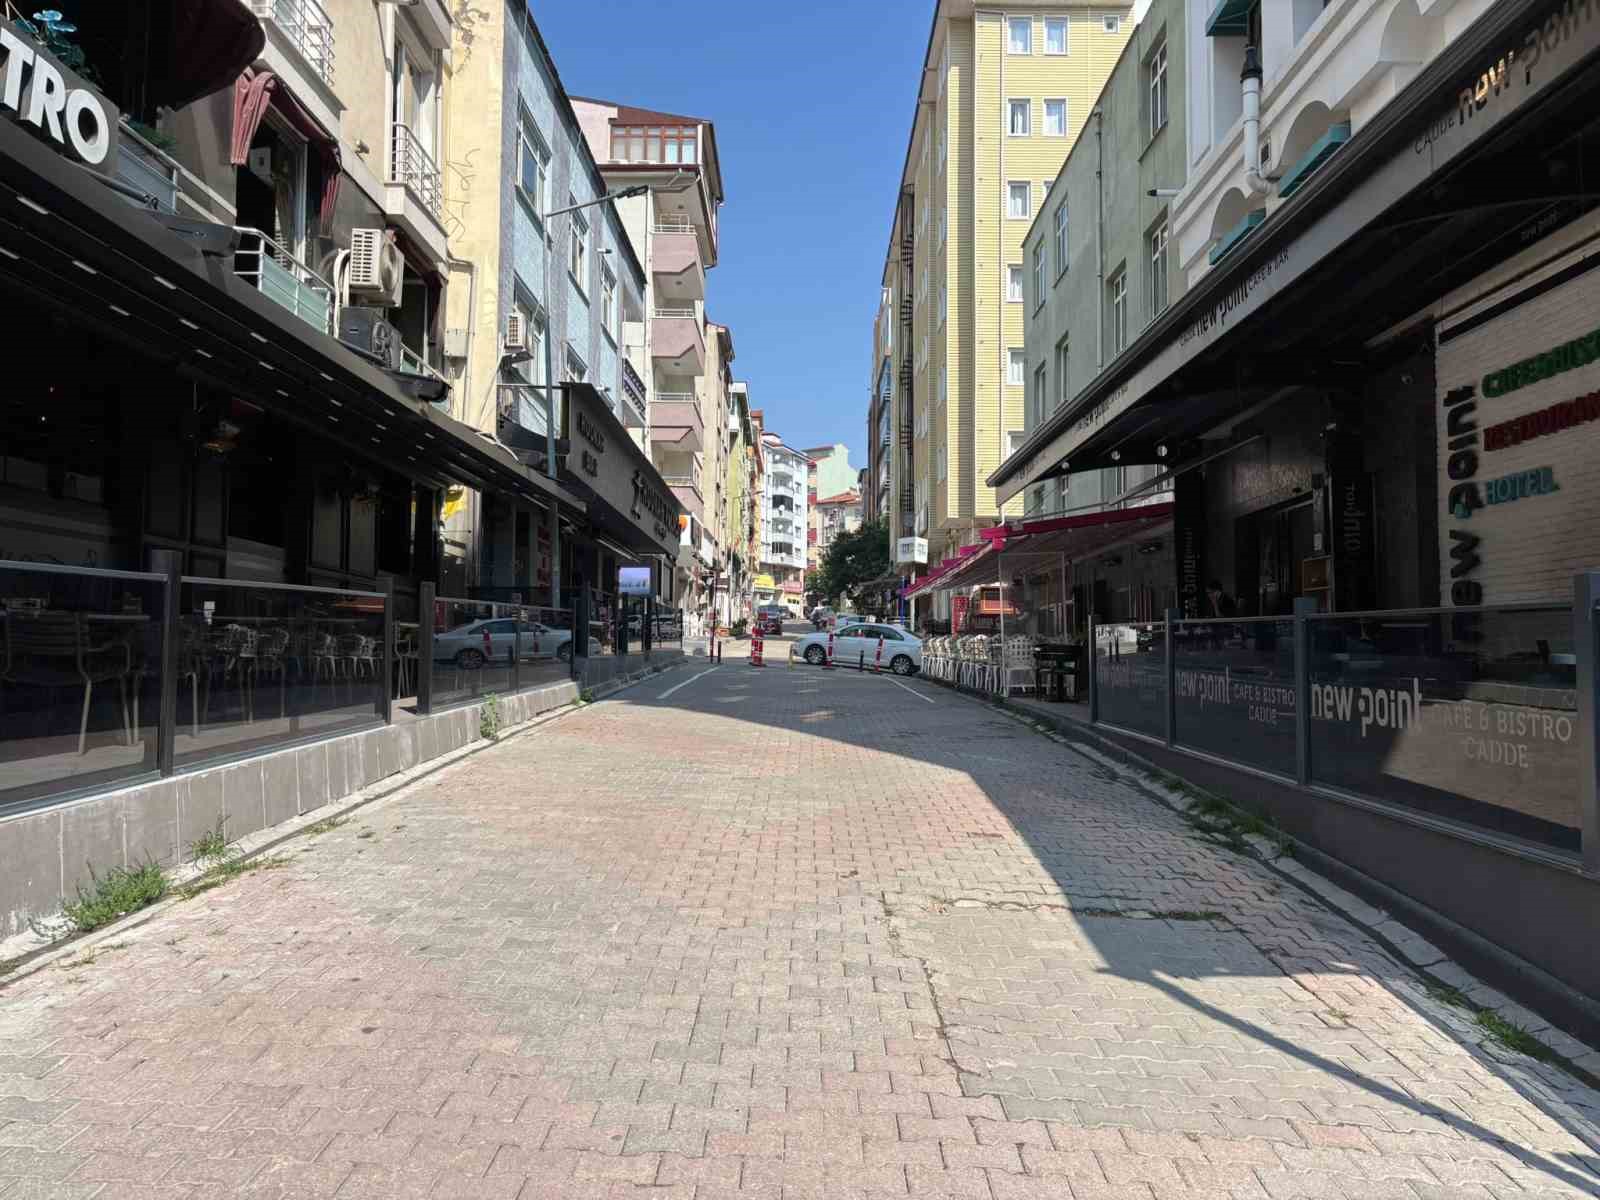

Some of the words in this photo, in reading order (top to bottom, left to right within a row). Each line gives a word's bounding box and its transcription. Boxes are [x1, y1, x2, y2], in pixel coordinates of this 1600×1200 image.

[1192, 303, 1218, 337] new
[1217, 278, 1249, 327] point
[1199, 663, 1232, 713] point
[1310, 683, 1352, 722] new
[1357, 676, 1424, 738] point
[1498, 709, 1574, 743] BISTRO
[1463, 736, 1530, 769] CADDE
